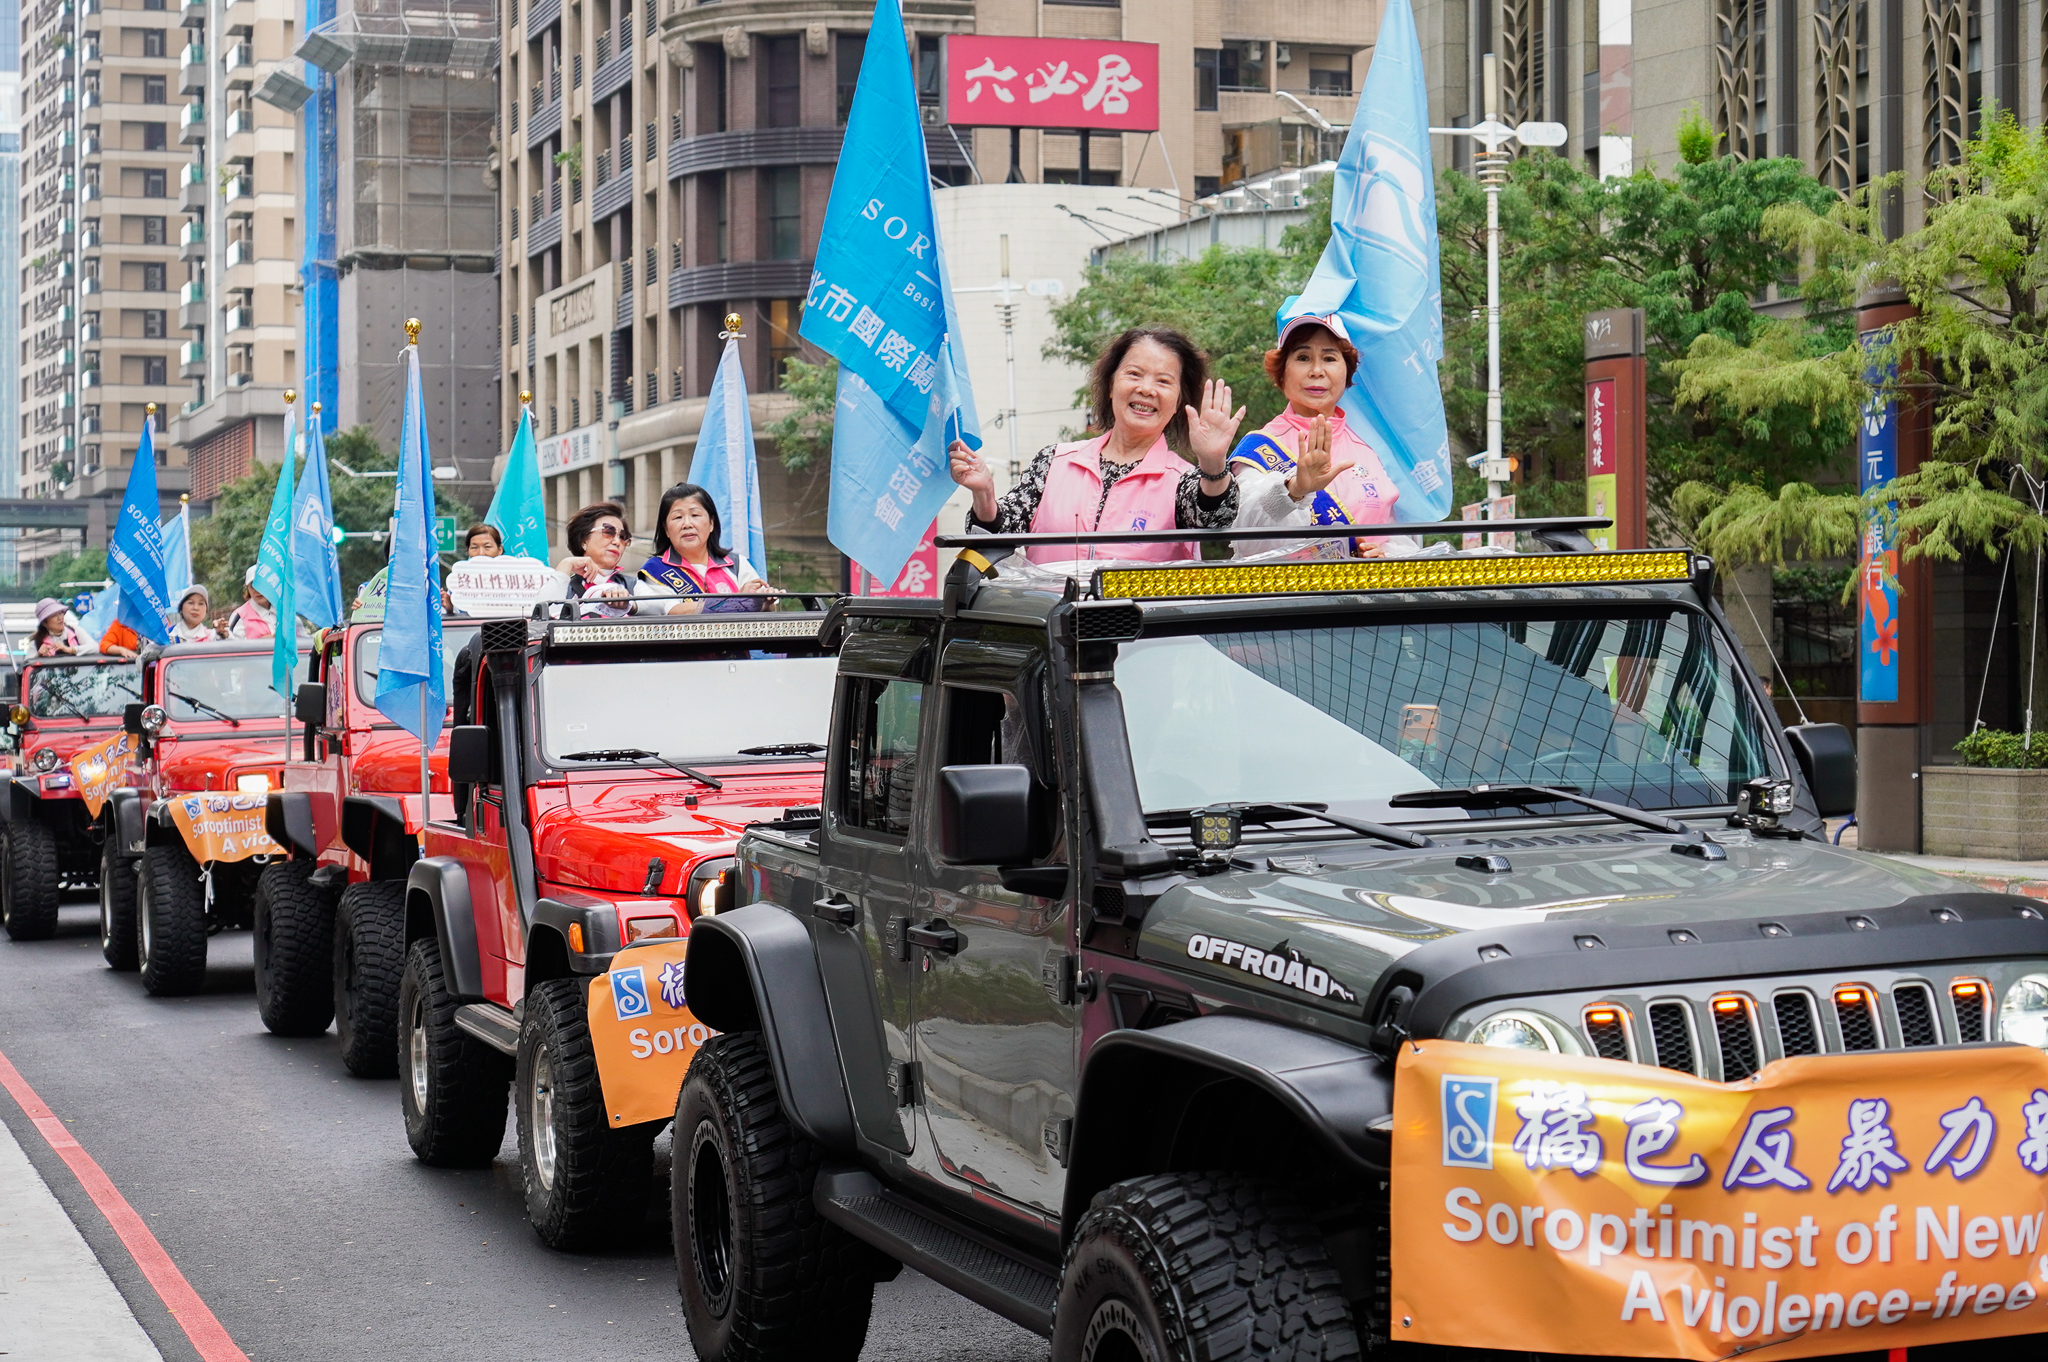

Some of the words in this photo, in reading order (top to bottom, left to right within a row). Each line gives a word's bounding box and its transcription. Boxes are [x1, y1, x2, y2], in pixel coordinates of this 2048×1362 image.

[963, 53, 1144, 116] 六必居
[861, 198, 940, 272] SOR
[903, 282, 937, 312] Best
[1592, 386, 1605, 468] 東方明珠
[1866, 450, 1885, 591] 元銀行
[192, 814, 263, 839] Soroptimist
[222, 837, 237, 853] A
[1187, 934, 1329, 997] OFFROAD
[1443, 1187, 1819, 1269] Soroptimist
[1835, 1204, 1897, 1266] of
[1915, 1205, 2044, 1262] New
[1620, 1270, 1666, 1323] A
[1681, 1272, 2037, 1338] violence-free
